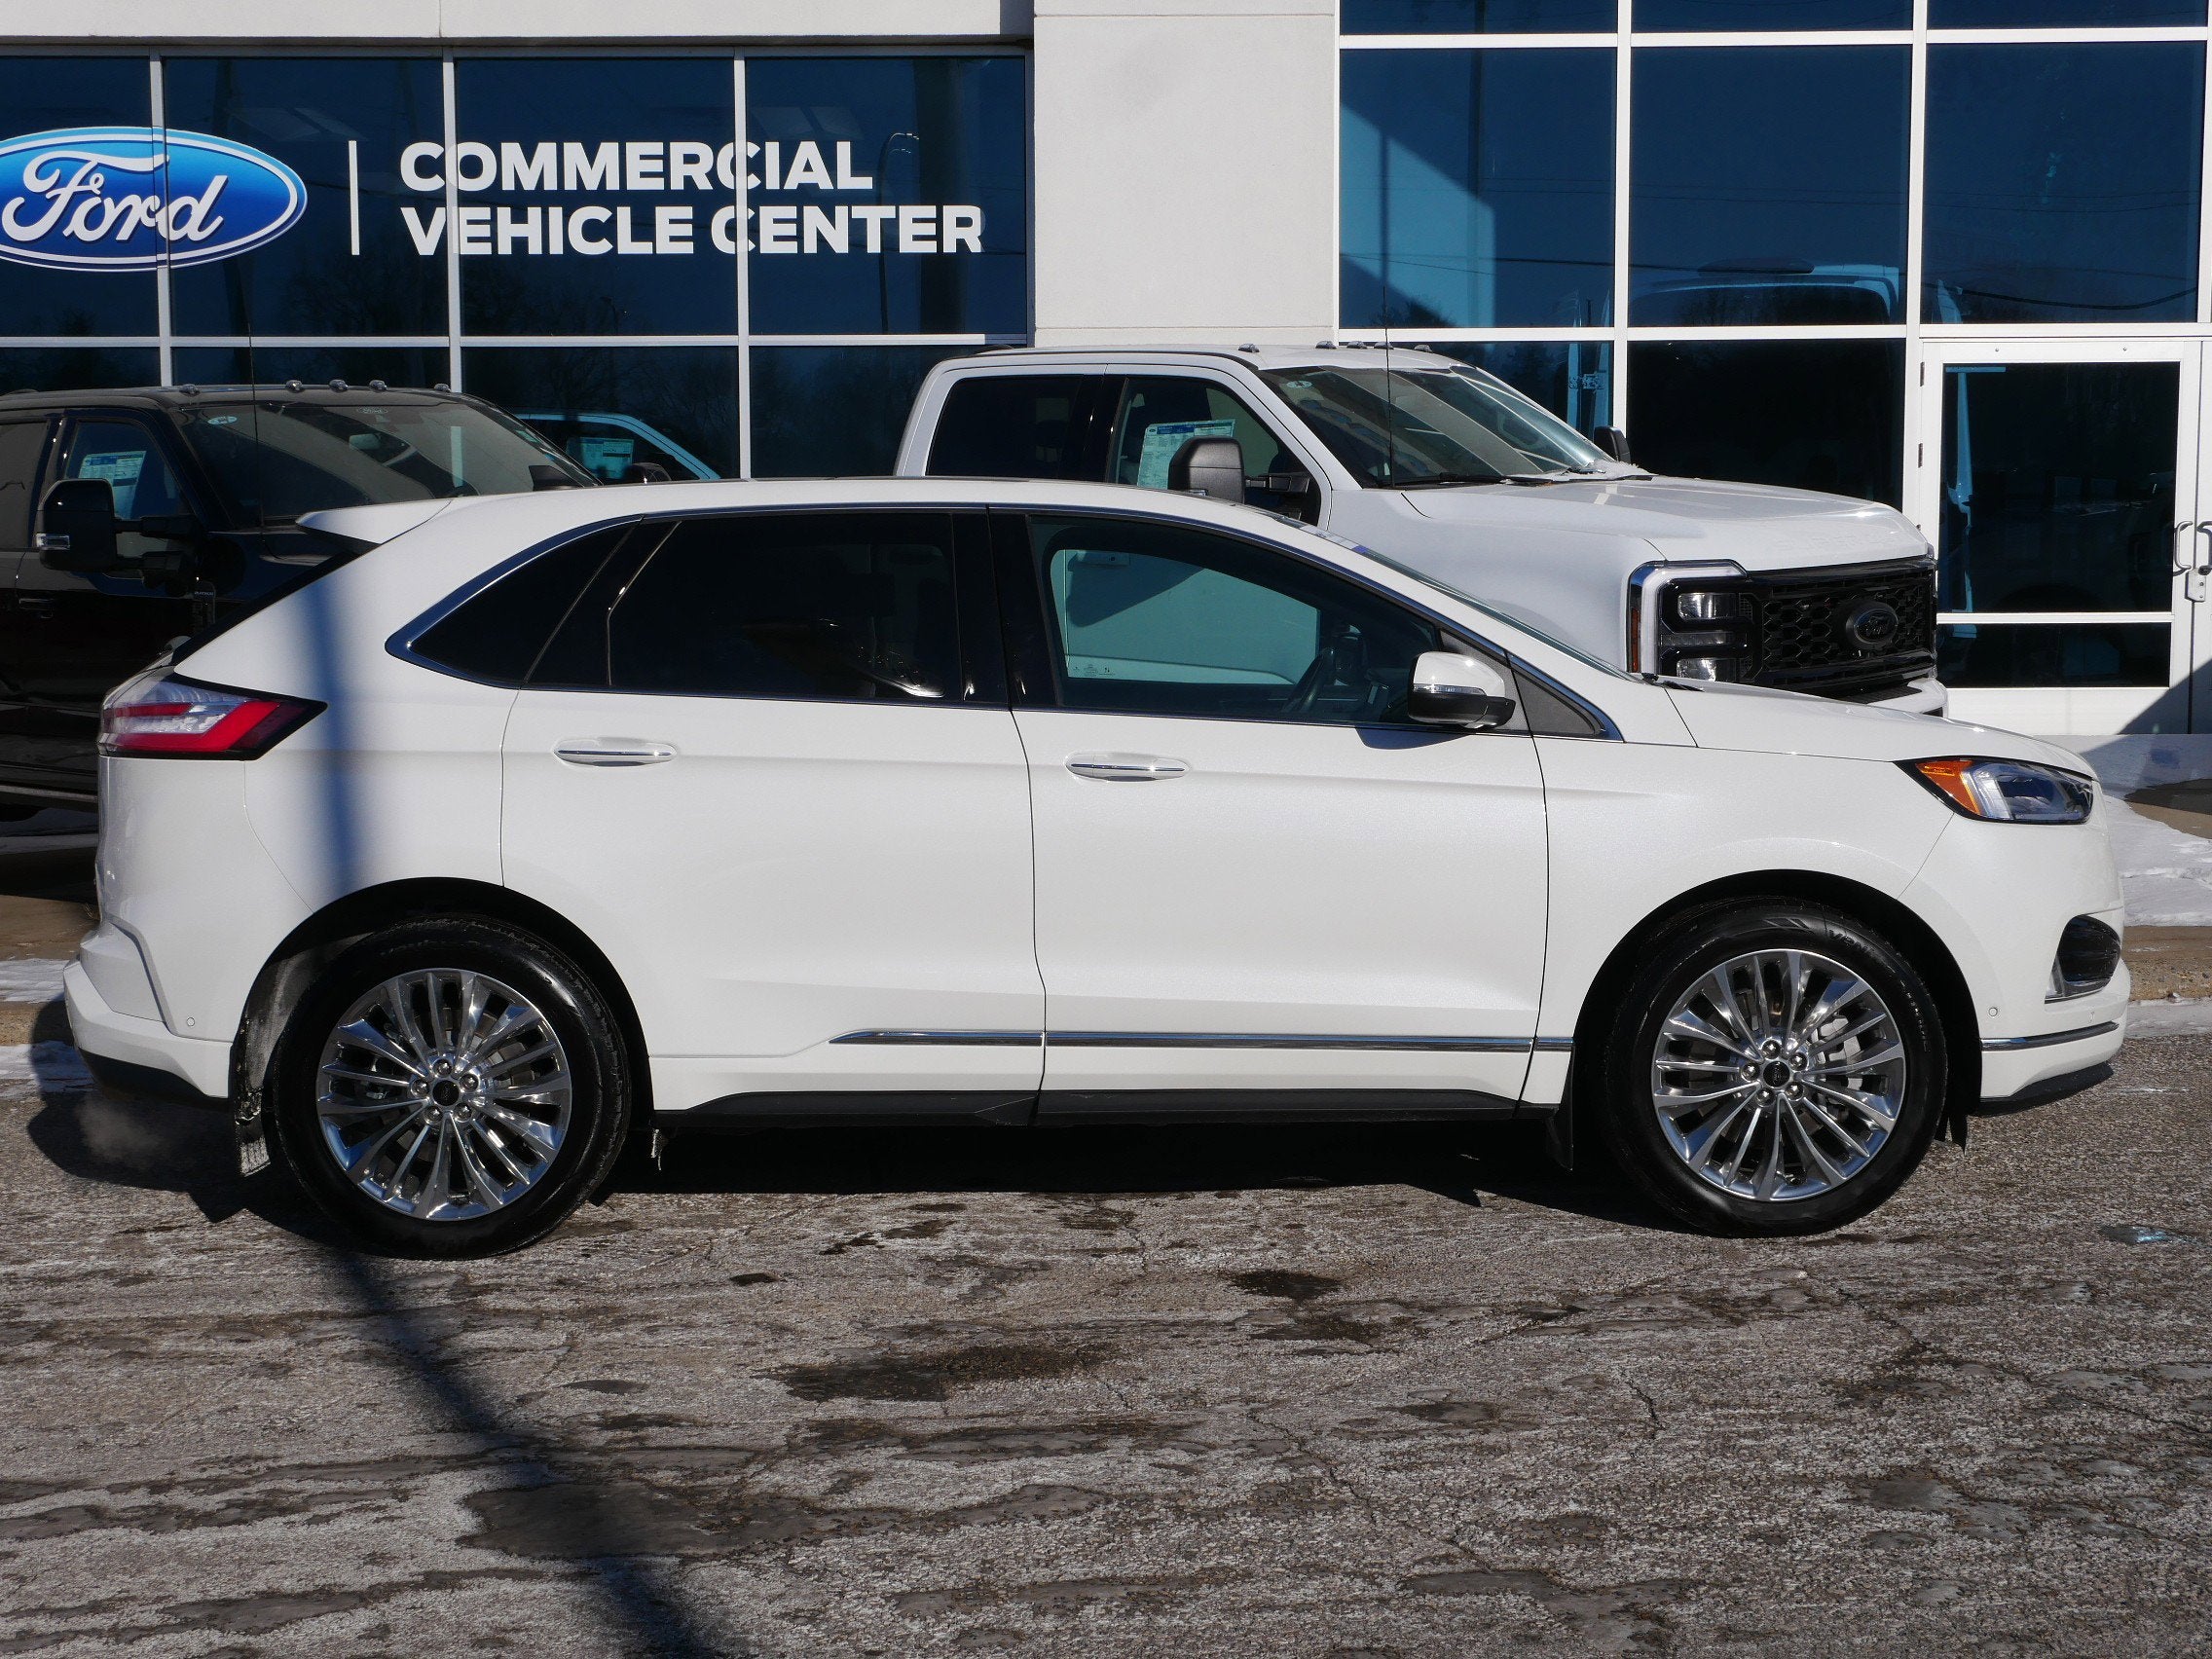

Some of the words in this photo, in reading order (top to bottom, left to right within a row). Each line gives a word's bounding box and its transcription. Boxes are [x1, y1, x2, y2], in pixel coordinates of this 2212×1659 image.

[400, 141, 873, 193] COMMERCIAL
[2, 150, 228, 241] Ford
[400, 205, 694, 256] VEHICLE
[711, 204, 986, 254] CENTER
